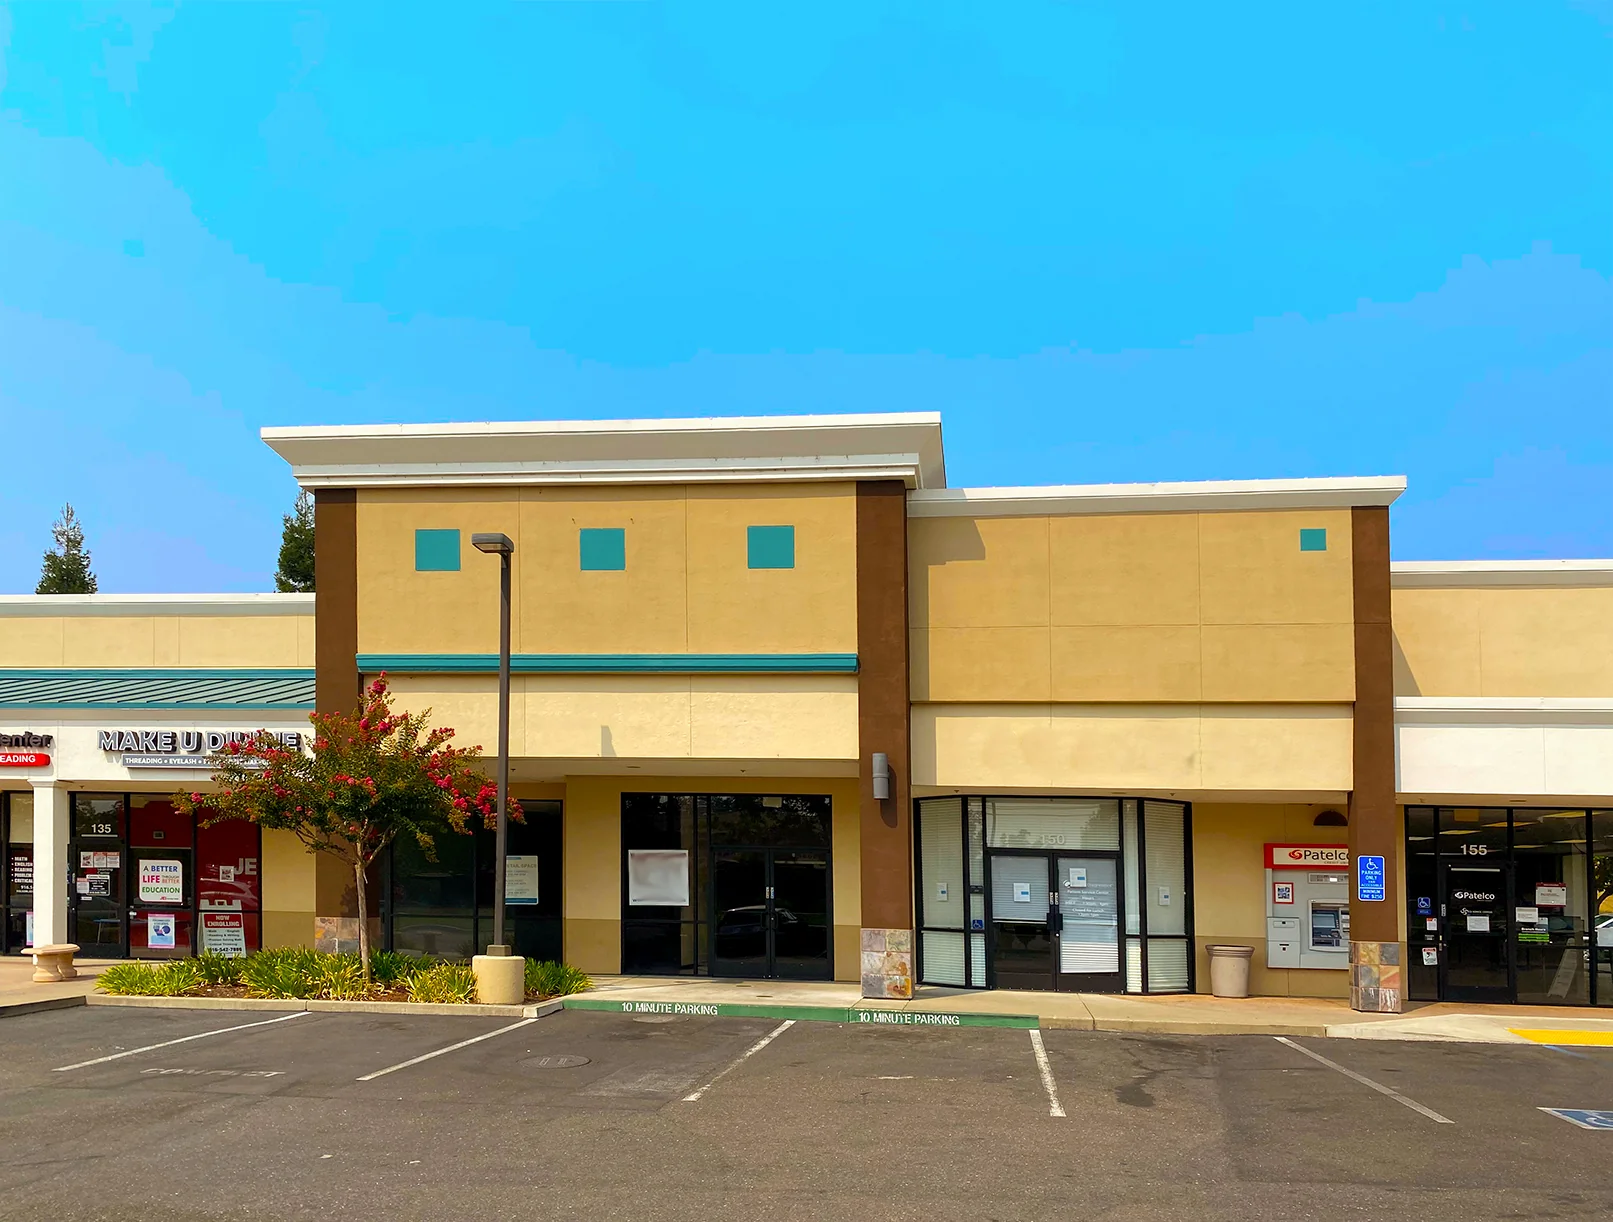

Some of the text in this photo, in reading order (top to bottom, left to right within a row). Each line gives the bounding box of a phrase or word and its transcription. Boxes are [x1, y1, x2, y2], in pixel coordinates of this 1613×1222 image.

[97, 730, 174, 752] MAKE
[179, 730, 200, 752] U
[125, 757, 163, 765] THREADING
[91, 823, 112, 834] 135
[1040, 834, 1065, 845] 150
[1460, 843, 1488, 856] 155
[142, 875, 161, 884] LIFE
[142, 886, 181, 894] EDUCATION
[1463, 891, 1496, 900] Patelco
[621, 1001, 718, 1016] 10 MINUTE PARKING
[858, 1012, 960, 1026] 10 MINUTE PARKING
